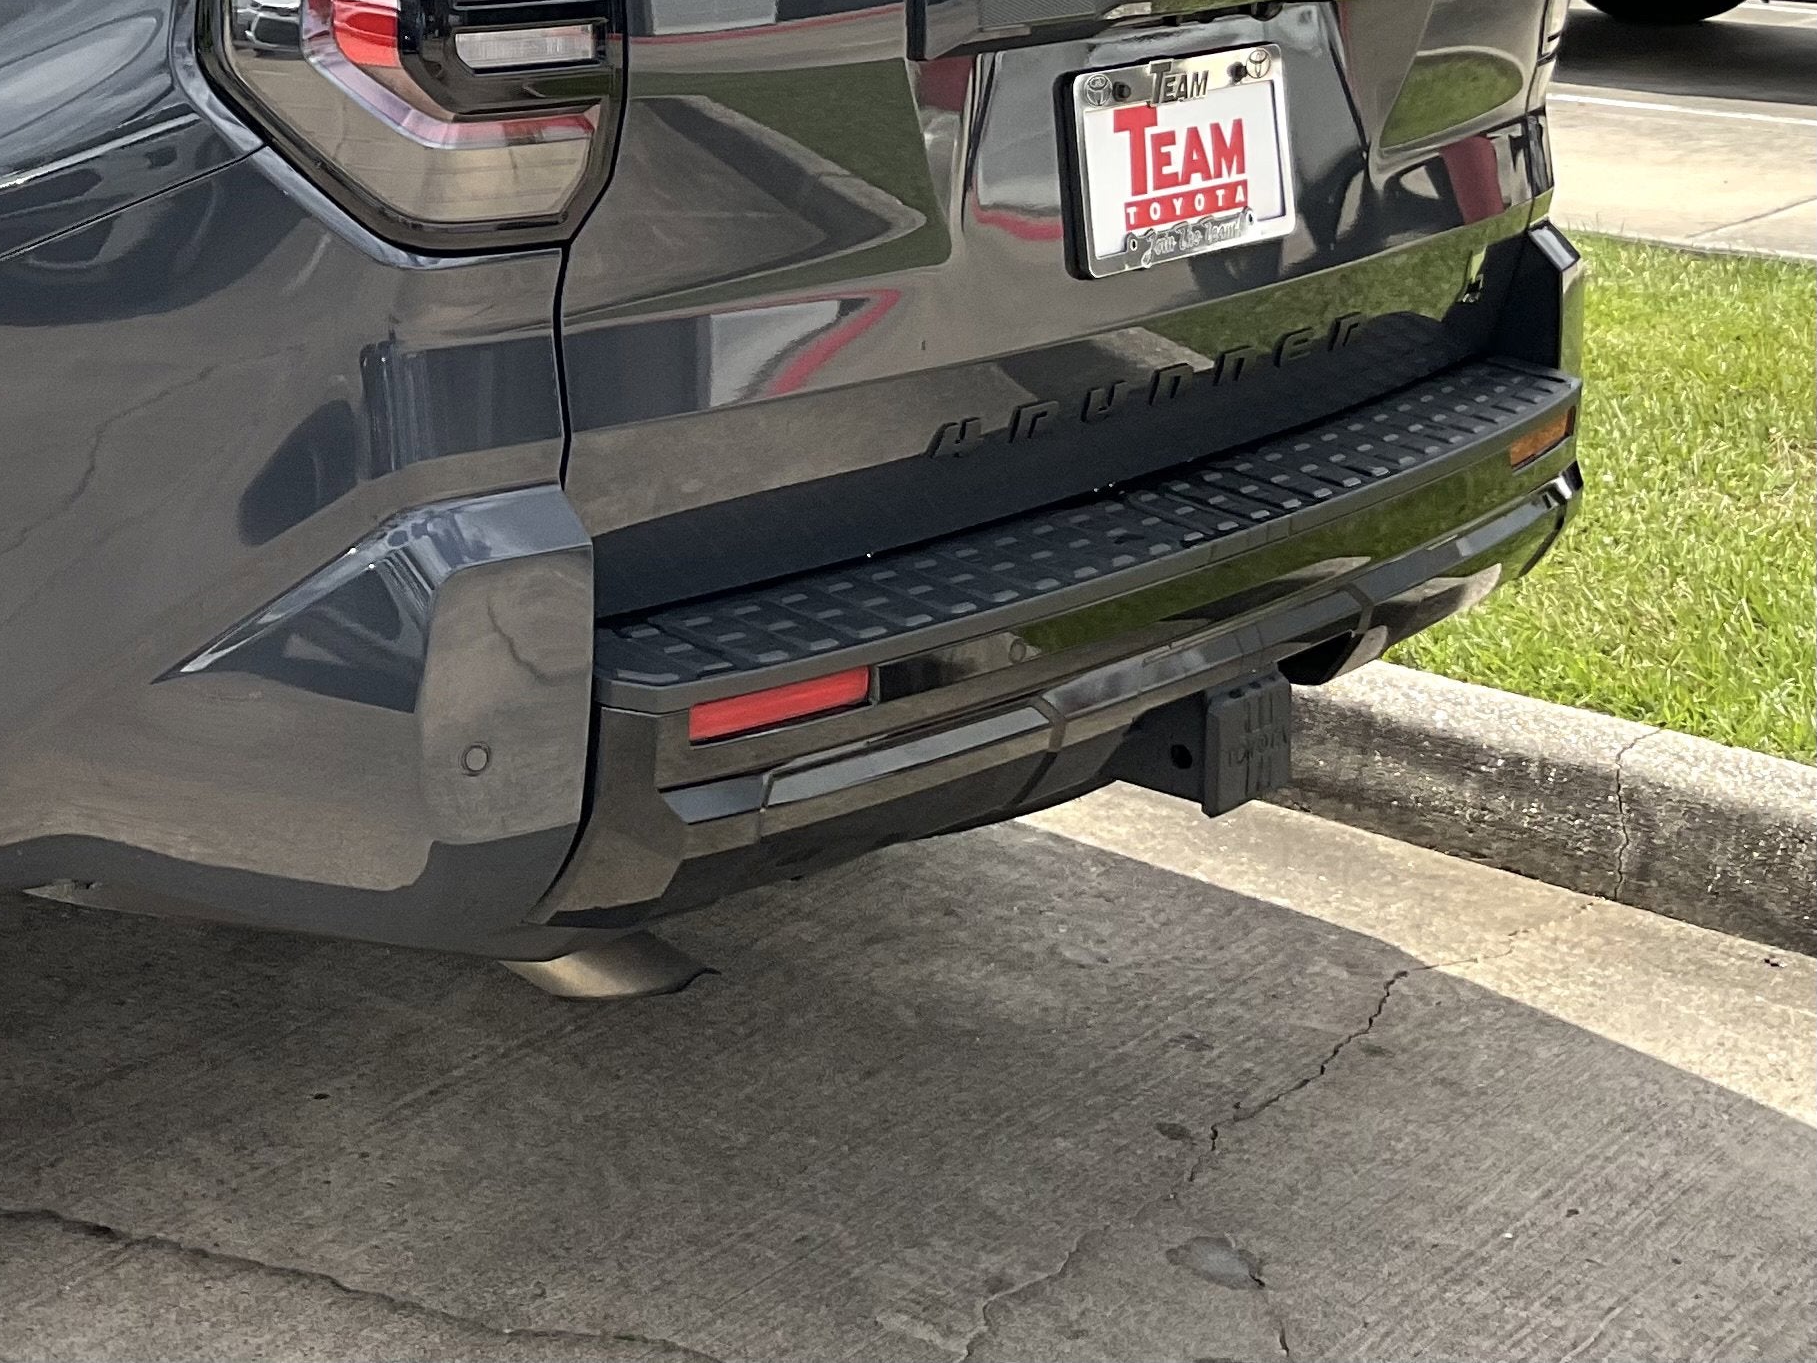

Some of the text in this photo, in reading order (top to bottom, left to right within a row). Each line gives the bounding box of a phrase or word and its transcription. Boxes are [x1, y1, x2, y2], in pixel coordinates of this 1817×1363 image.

[1149, 61, 1209, 106] TEAM
[1113, 105, 1245, 196] TEAM
[1126, 185, 1246, 224] TOYOTA
